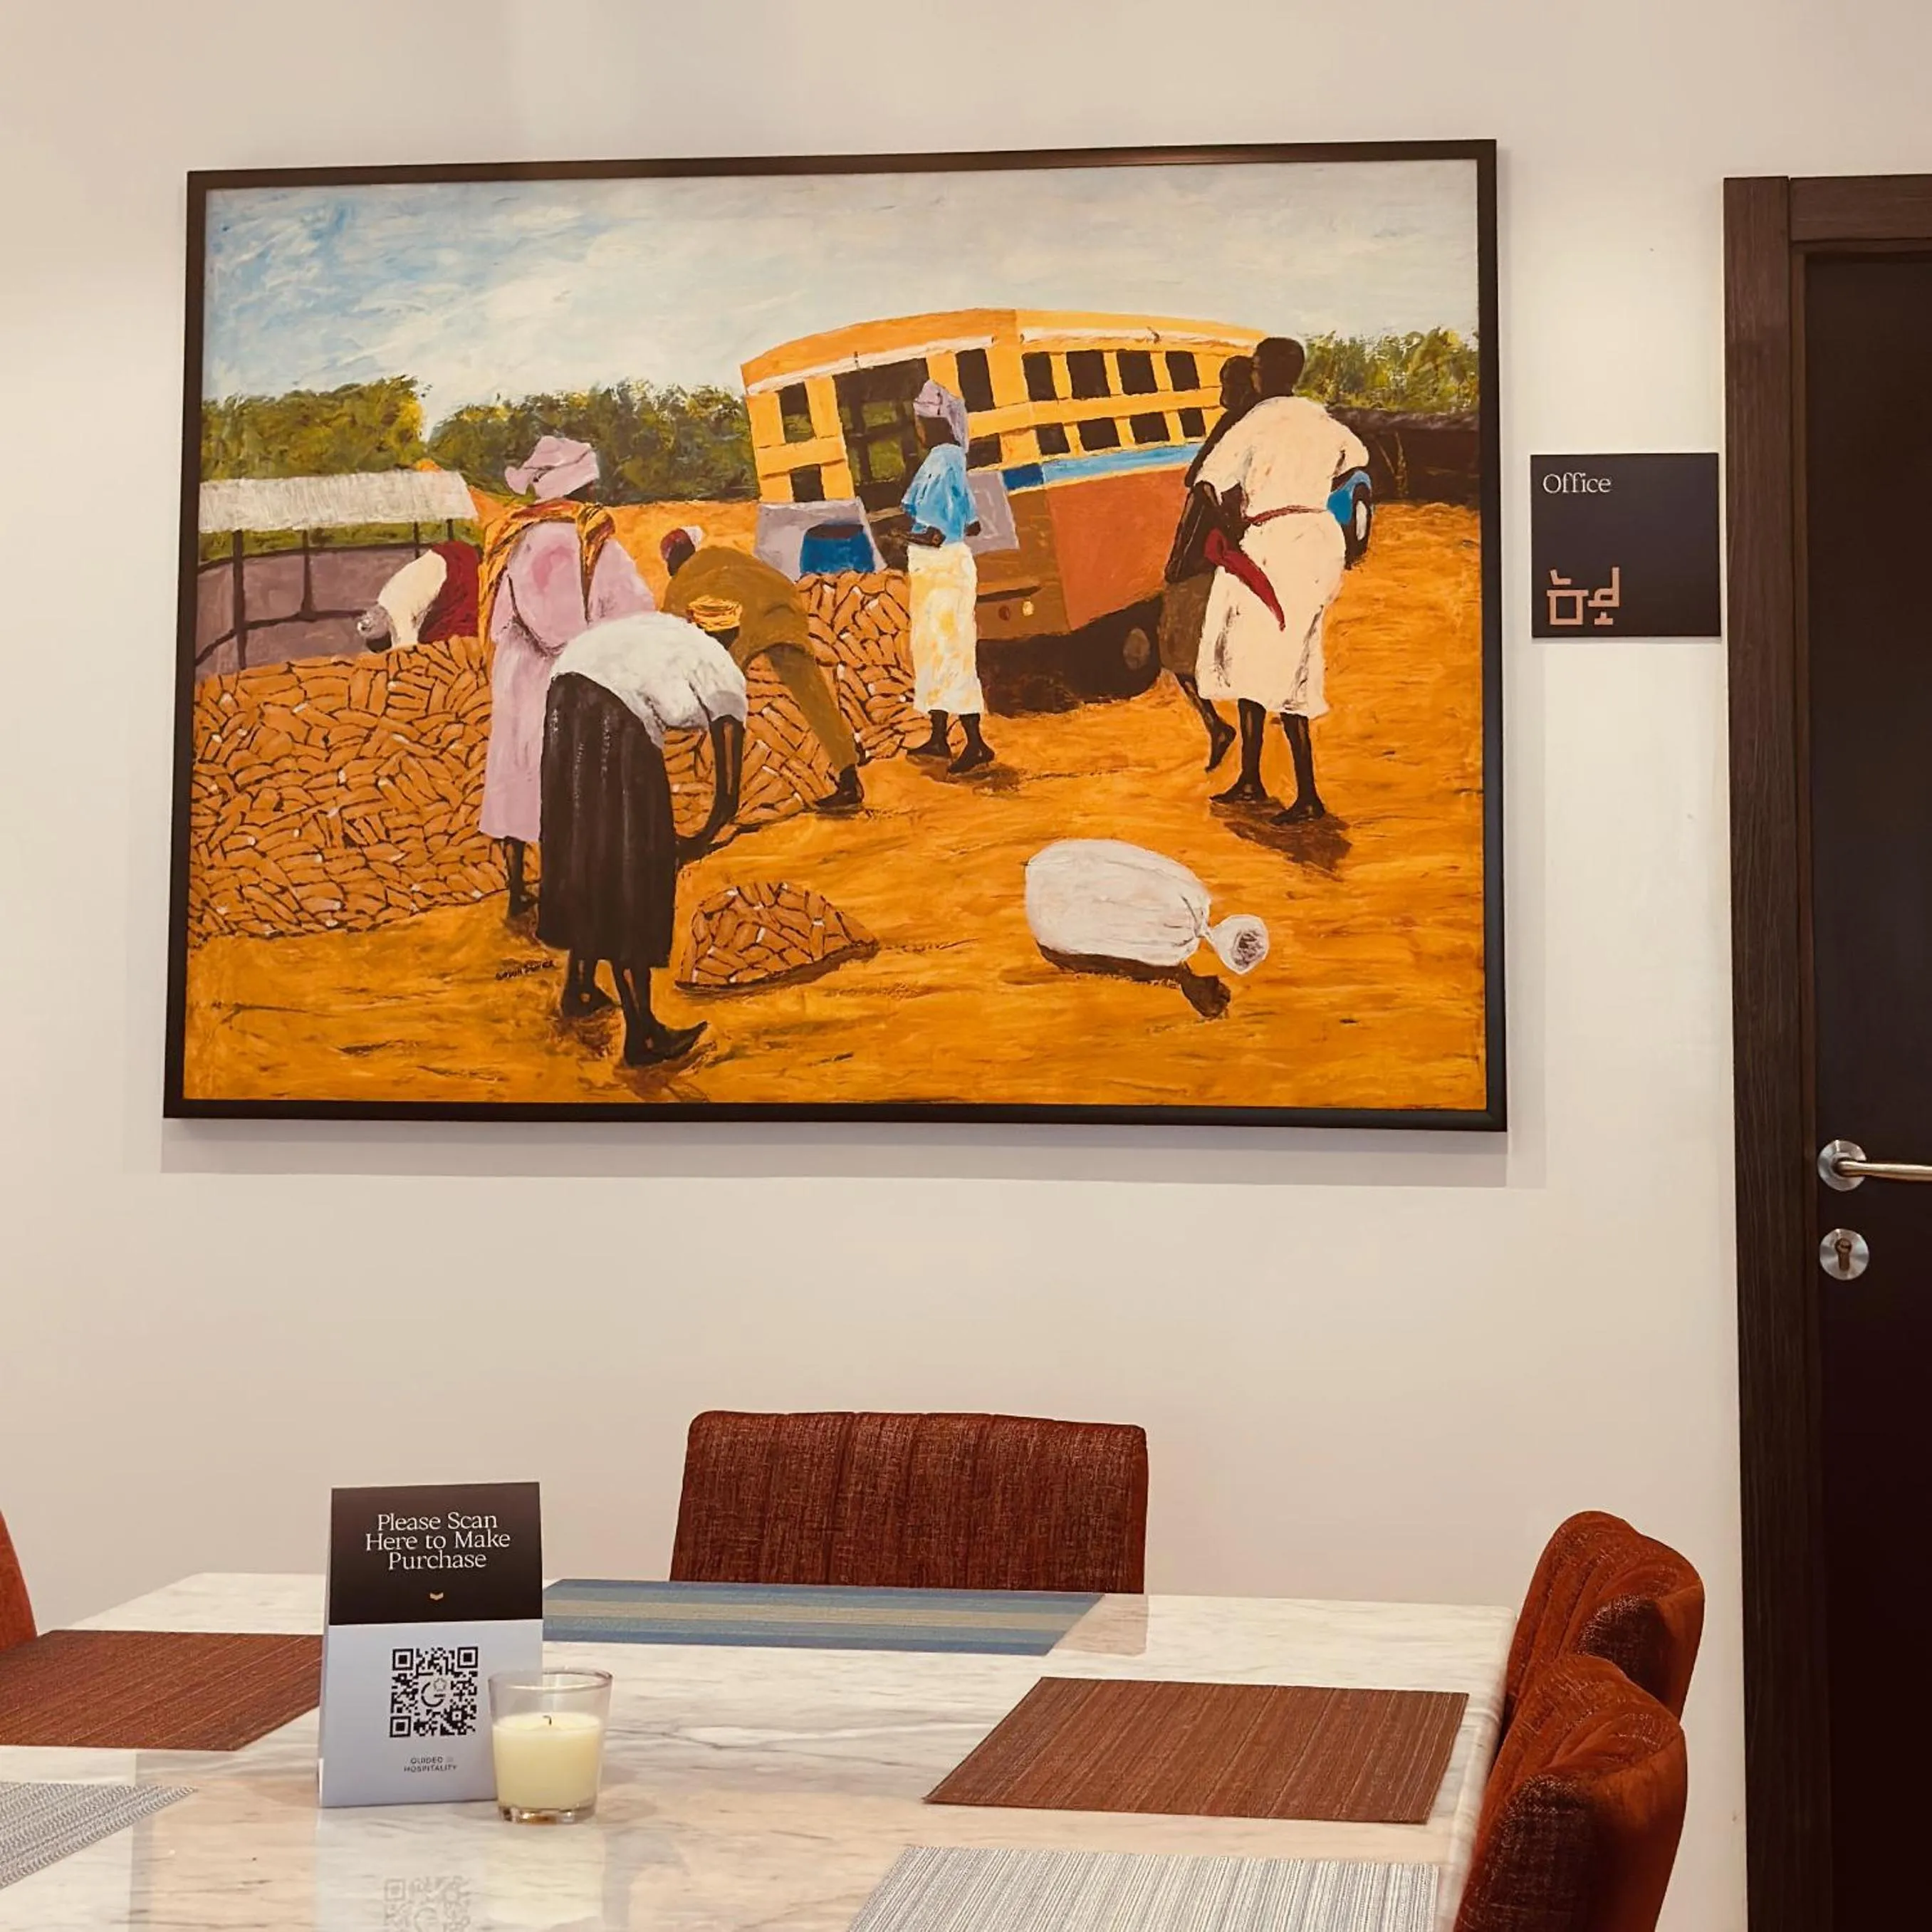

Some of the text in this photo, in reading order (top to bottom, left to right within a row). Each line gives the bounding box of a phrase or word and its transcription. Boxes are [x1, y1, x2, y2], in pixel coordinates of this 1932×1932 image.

[1542, 472, 1612, 494] Office
[377, 1511, 498, 1531] Please Scan
[365, 1529, 511, 1551] Here to Make
[389, 1550, 487, 1570] Purchase
